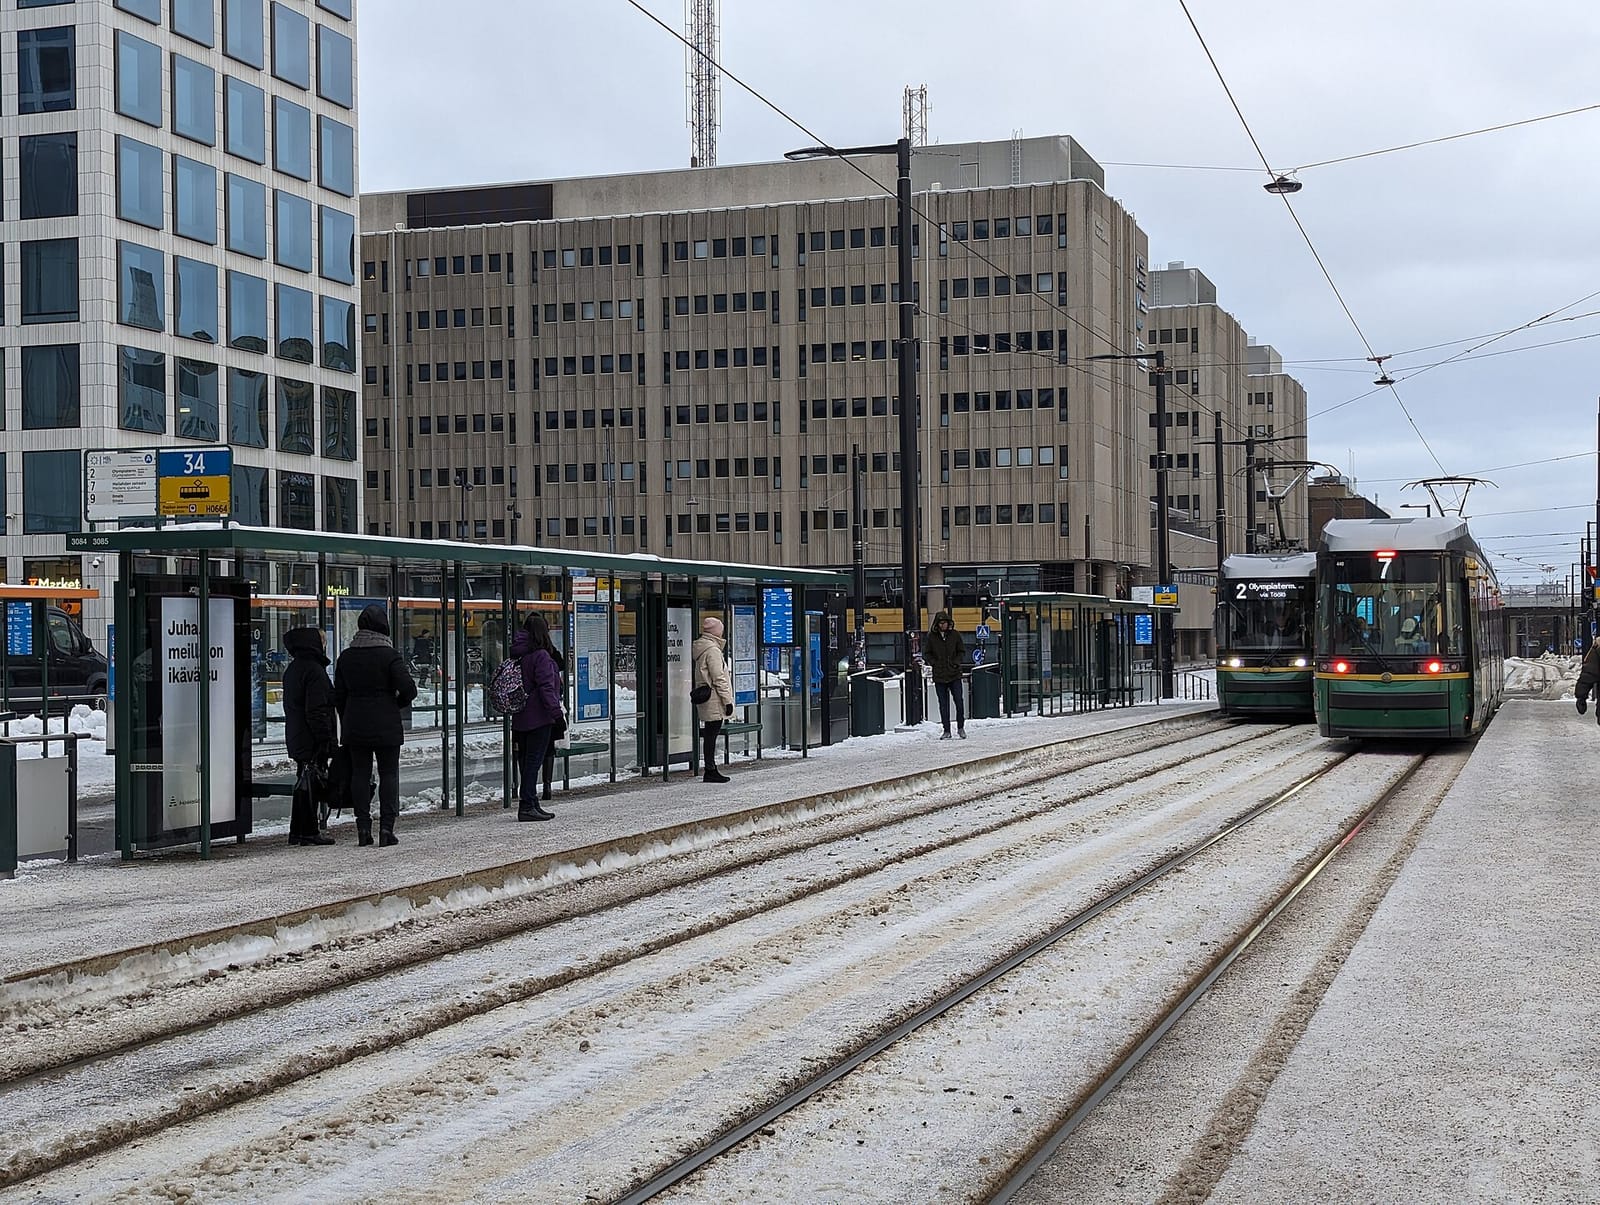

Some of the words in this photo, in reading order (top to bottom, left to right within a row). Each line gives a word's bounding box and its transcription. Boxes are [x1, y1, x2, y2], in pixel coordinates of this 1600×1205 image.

[184, 454, 205, 474] 34
[90, 469, 95, 478] 2
[91, 481, 95, 491] 7
[90, 494, 95, 503] 9
[1378, 558, 1392, 579] 7
[39, 577, 80, 588] Market
[328, 585, 348, 595] Market
[1236, 583, 1247, 599] 2
[210, 646, 223, 658] on
